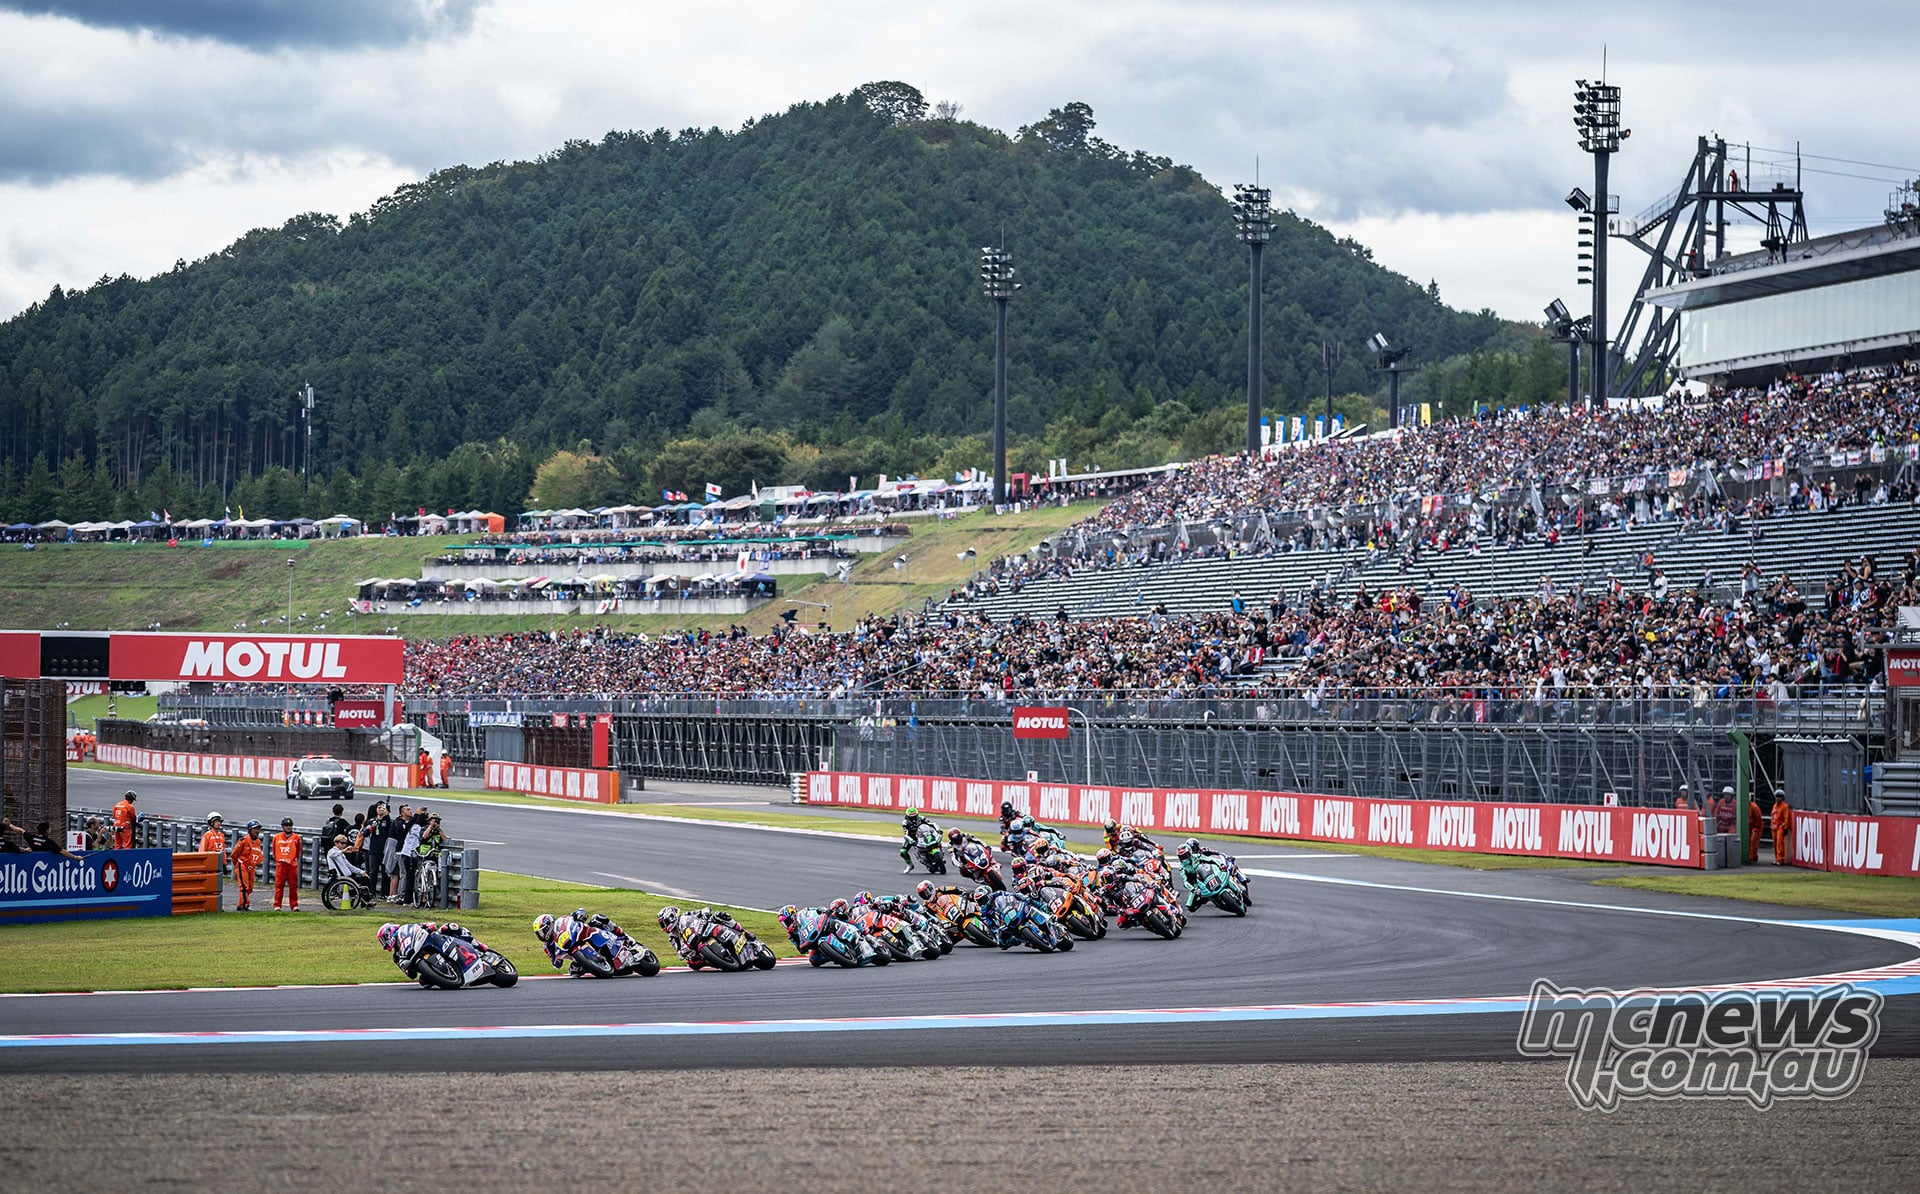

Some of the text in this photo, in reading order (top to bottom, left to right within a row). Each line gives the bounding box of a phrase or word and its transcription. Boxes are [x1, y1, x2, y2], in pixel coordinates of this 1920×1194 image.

[179, 641, 347, 678] MOTUL
[1889, 658, 1920, 669] MOT
[338, 709, 377, 719] MOTUL
[1016, 716, 1065, 729] MOTUL
[809, 774, 832, 802] MOTUL
[838, 775, 862, 803] MOTUL
[868, 777, 892, 806] MOTUL
[899, 779, 924, 808] MOTUL
[931, 780, 958, 811] MOTUL
[966, 783, 994, 815] MOTUL
[1002, 785, 1031, 816] MOTUL
[1040, 787, 1070, 820] MOTUL
[1079, 789, 1111, 823] MOTUL
[1120, 792, 1154, 827] MOTUL
[1164, 793, 1200, 828] MOTUL
[1211, 794, 1249, 831] MOTUL
[1260, 796, 1300, 834] MOTUL
[1312, 799, 1355, 839] MOTUL
[1368, 803, 1413, 844] MOTUL
[1427, 806, 1476, 847] MOTUL
[1491, 807, 1542, 850] MOTUL
[1558, 810, 1613, 855] MOTUL
[1631, 813, 1690, 860] MOTUL
[1795, 816, 1824, 864] MOTUL
[1834, 820, 1883, 869] MOTUL
[32, 860, 96, 893] Galicia
